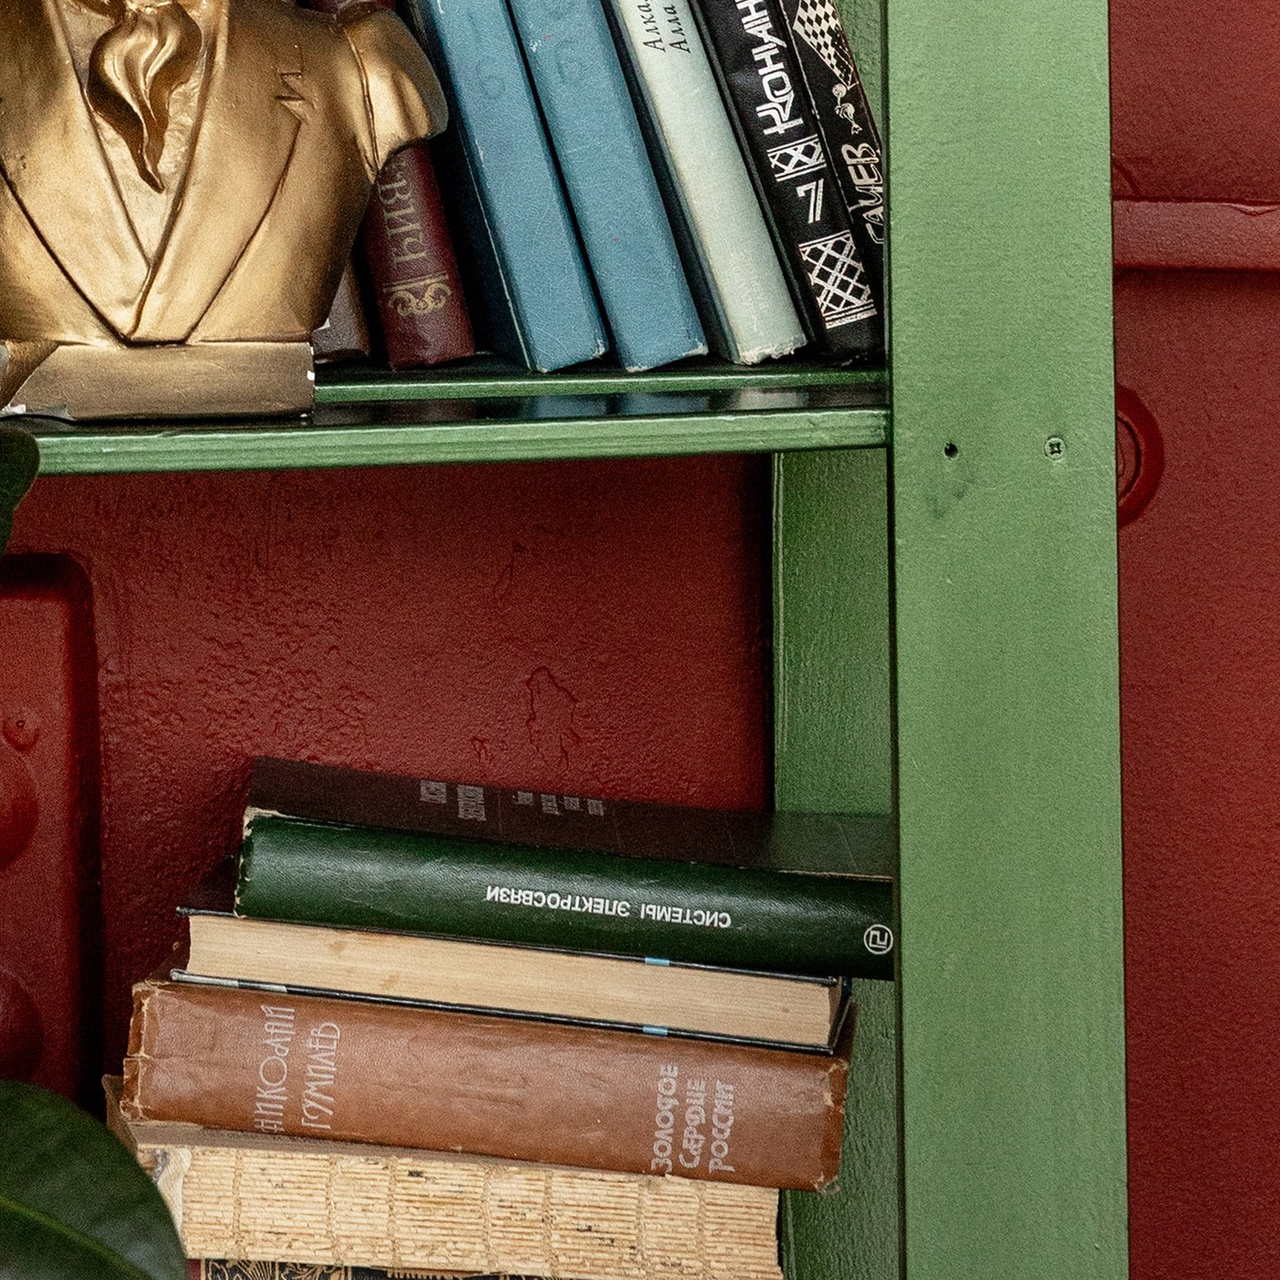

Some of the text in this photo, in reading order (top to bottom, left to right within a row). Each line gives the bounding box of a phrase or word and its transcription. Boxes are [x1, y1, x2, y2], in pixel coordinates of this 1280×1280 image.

[668, 2, 691, 55] Алла
[796, 177, 825, 225] 7
[483, 884, 732, 929] СИСТЕМЫ ЭЛЕКТРОСВЯЗИ
